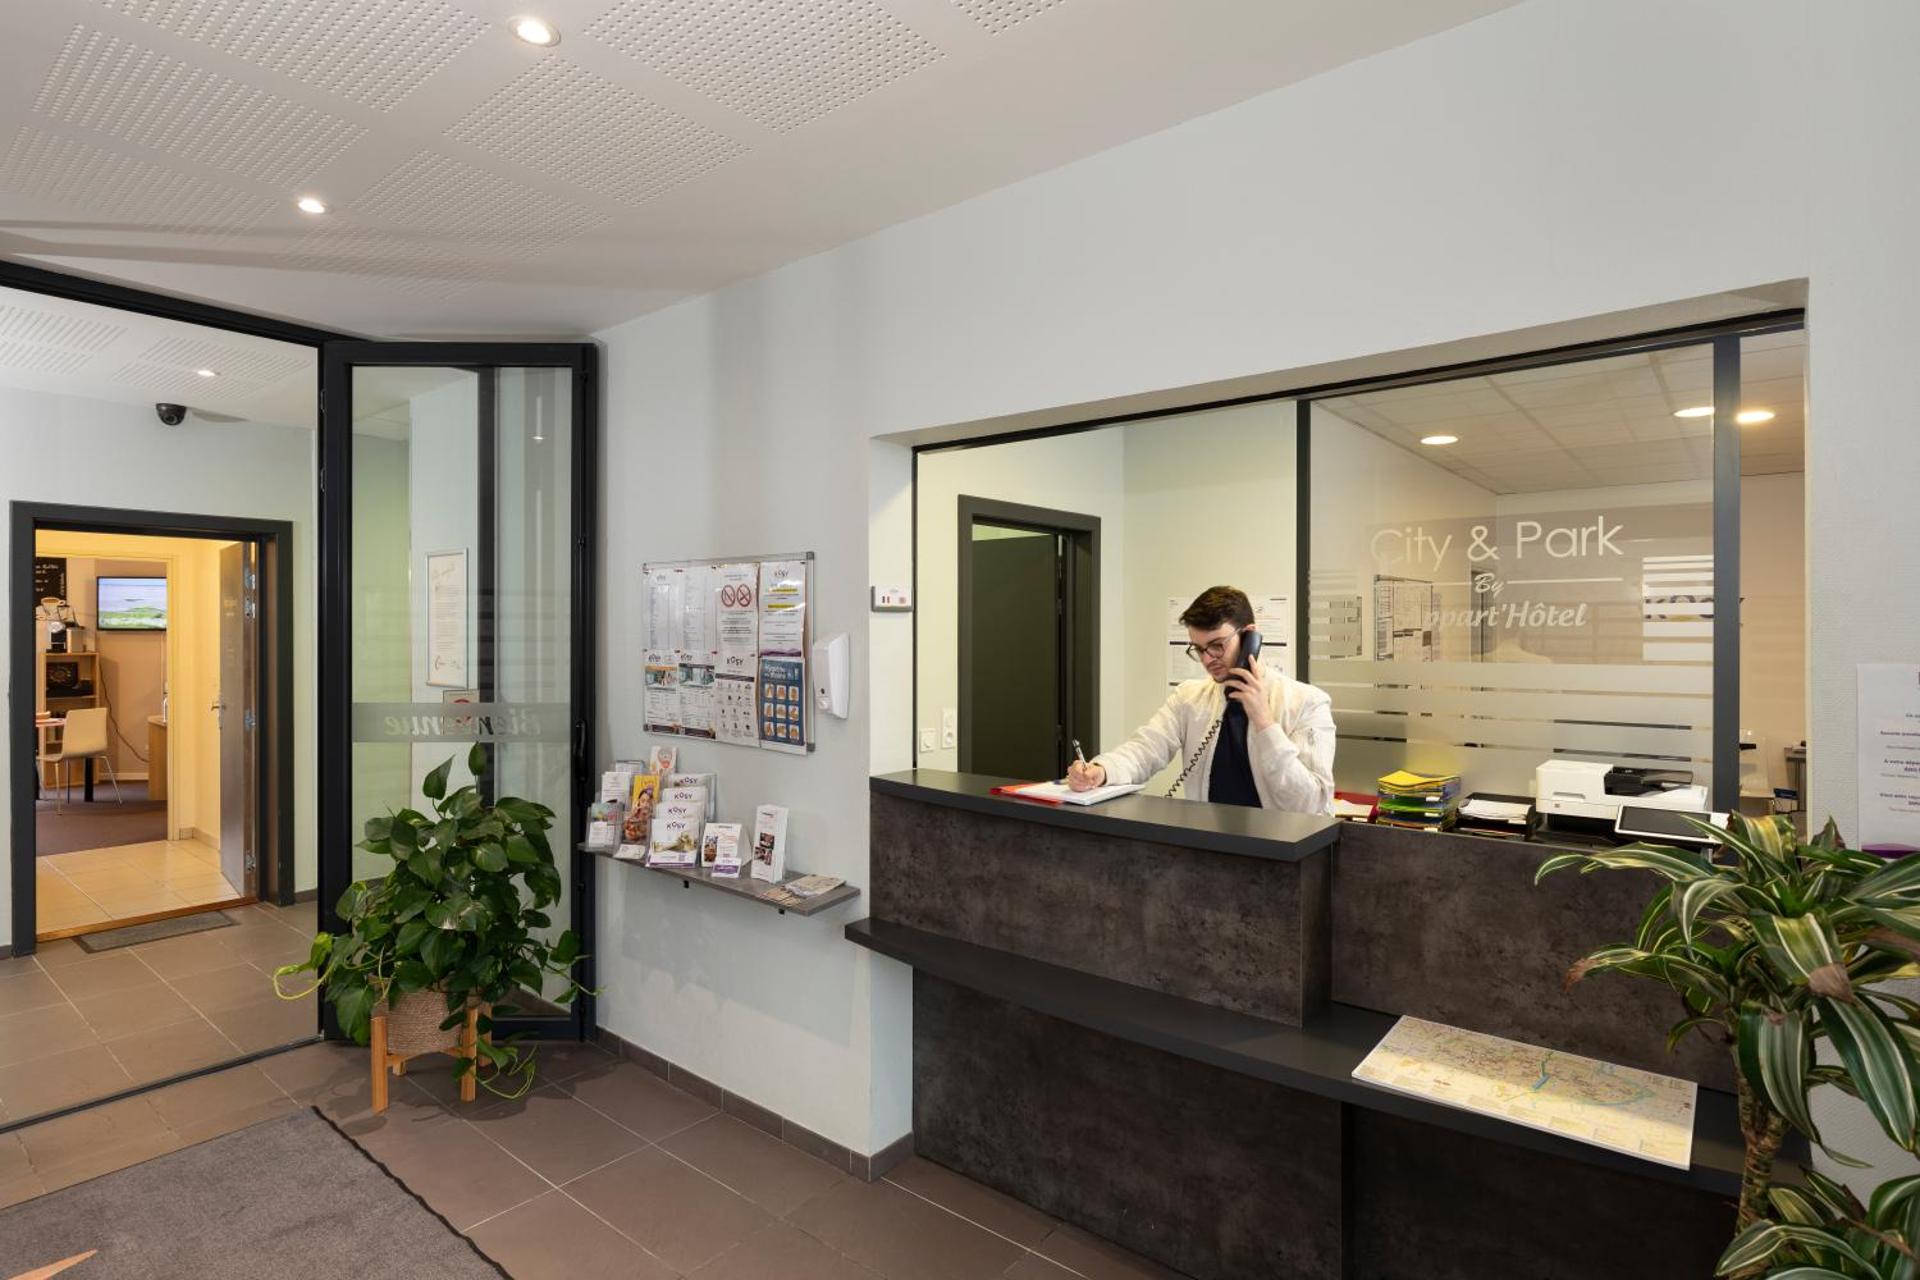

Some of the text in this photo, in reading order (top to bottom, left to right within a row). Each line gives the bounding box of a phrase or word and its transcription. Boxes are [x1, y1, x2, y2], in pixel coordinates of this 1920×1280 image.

[1371, 515, 1624, 572] City & Park
[1474, 572, 1505, 600] By
[1405, 600, 1587, 630] ppart'Hôtel
[726, 656, 744, 666] KOSY
[668, 807, 686, 815] KOSY
[667, 821, 685, 829] KOSY
